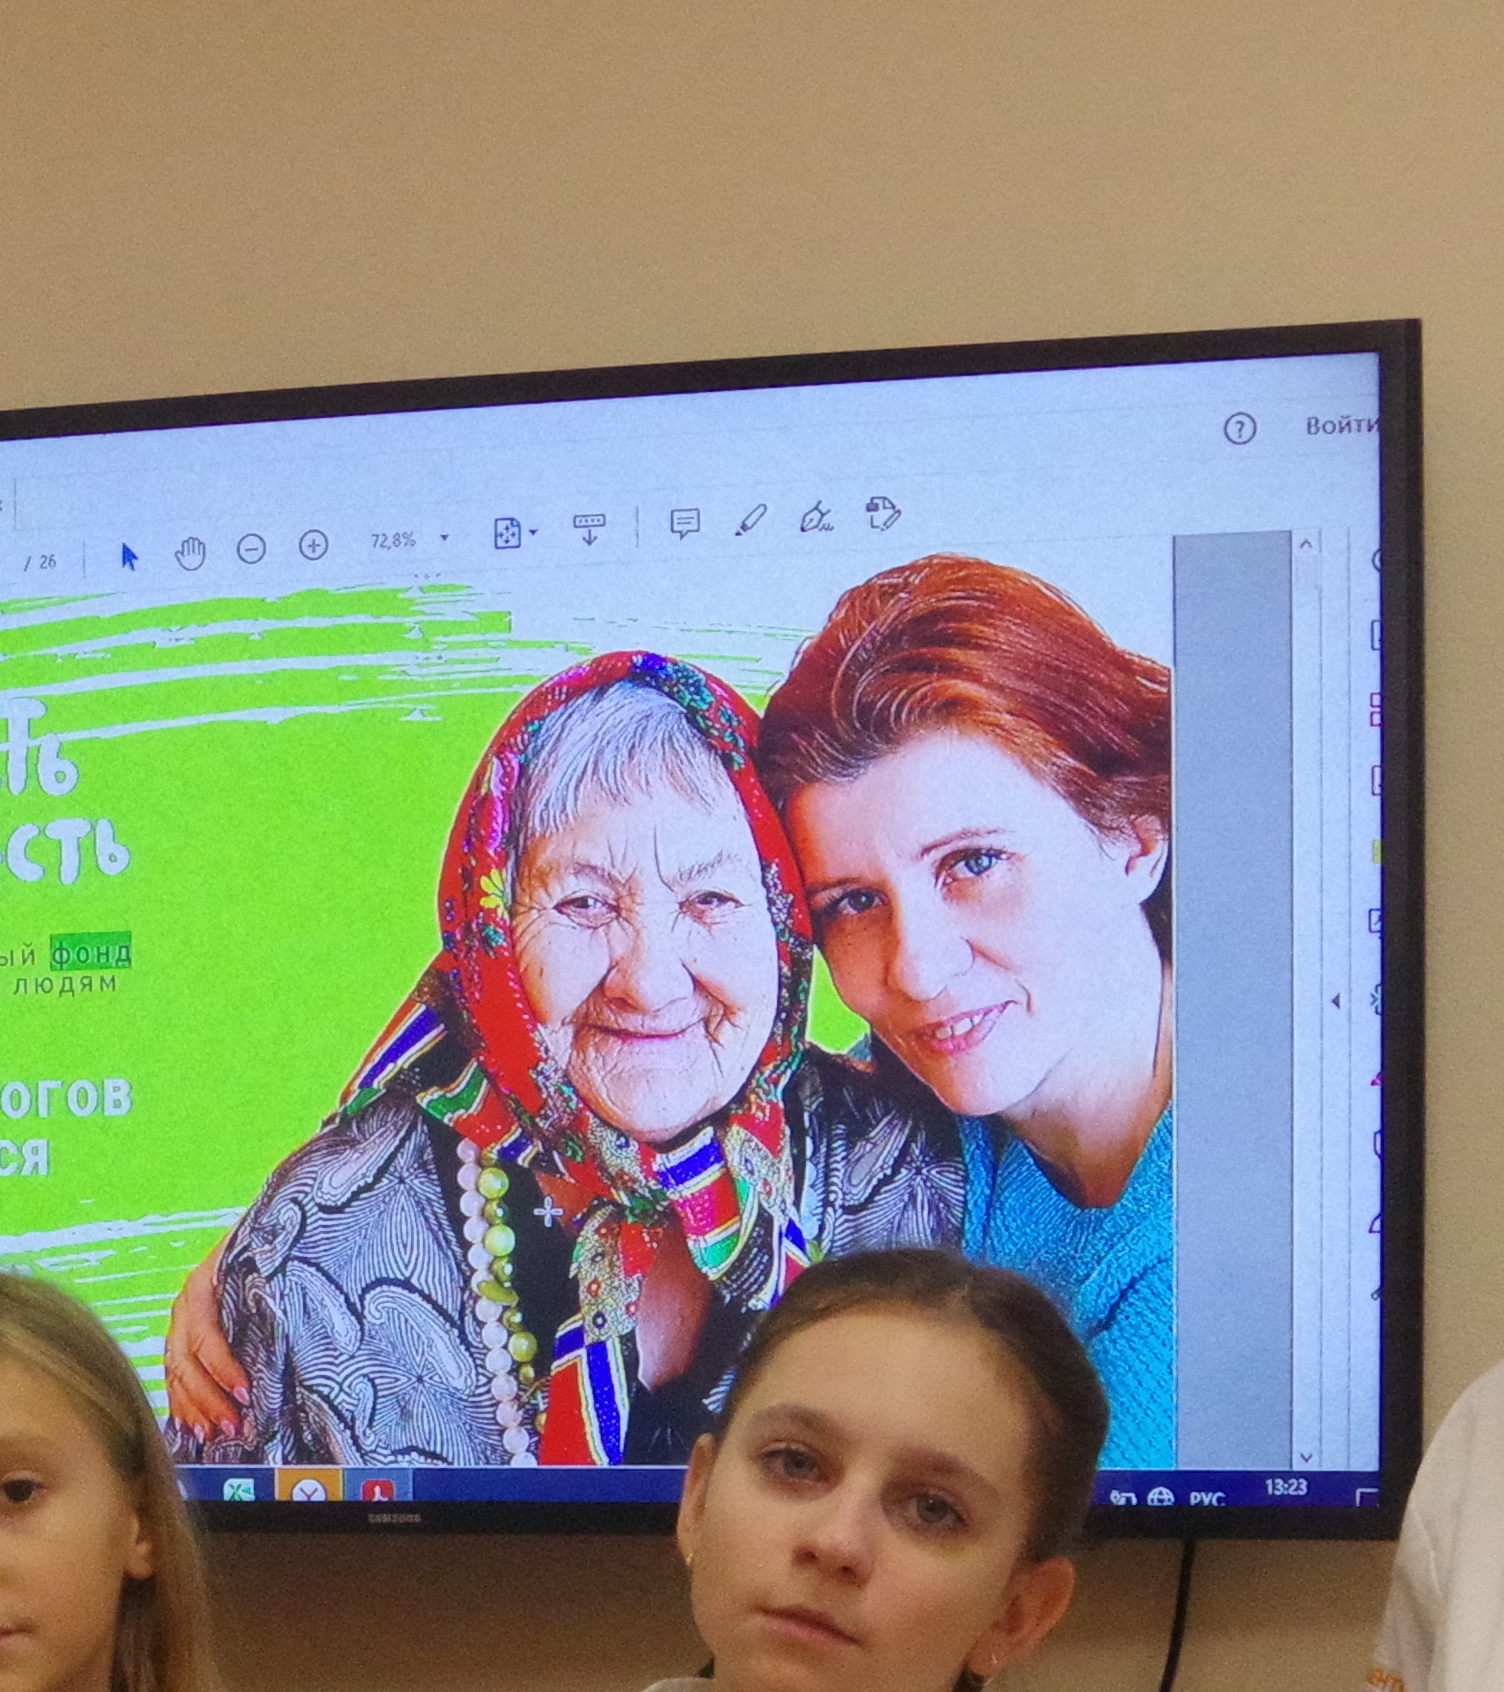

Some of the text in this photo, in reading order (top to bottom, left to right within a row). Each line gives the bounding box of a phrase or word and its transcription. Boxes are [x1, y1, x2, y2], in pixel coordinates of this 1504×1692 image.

[1307, 415, 1380, 435] Войти
[371, 531, 417, 550] 72,8%
[40, 553, 57, 570] 26
[50, 936, 132, 971] фонд
[13, 971, 118, 998] людям
[1265, 1478, 1308, 1497] 13:23
[1190, 1491, 1227, 1507] РУС
